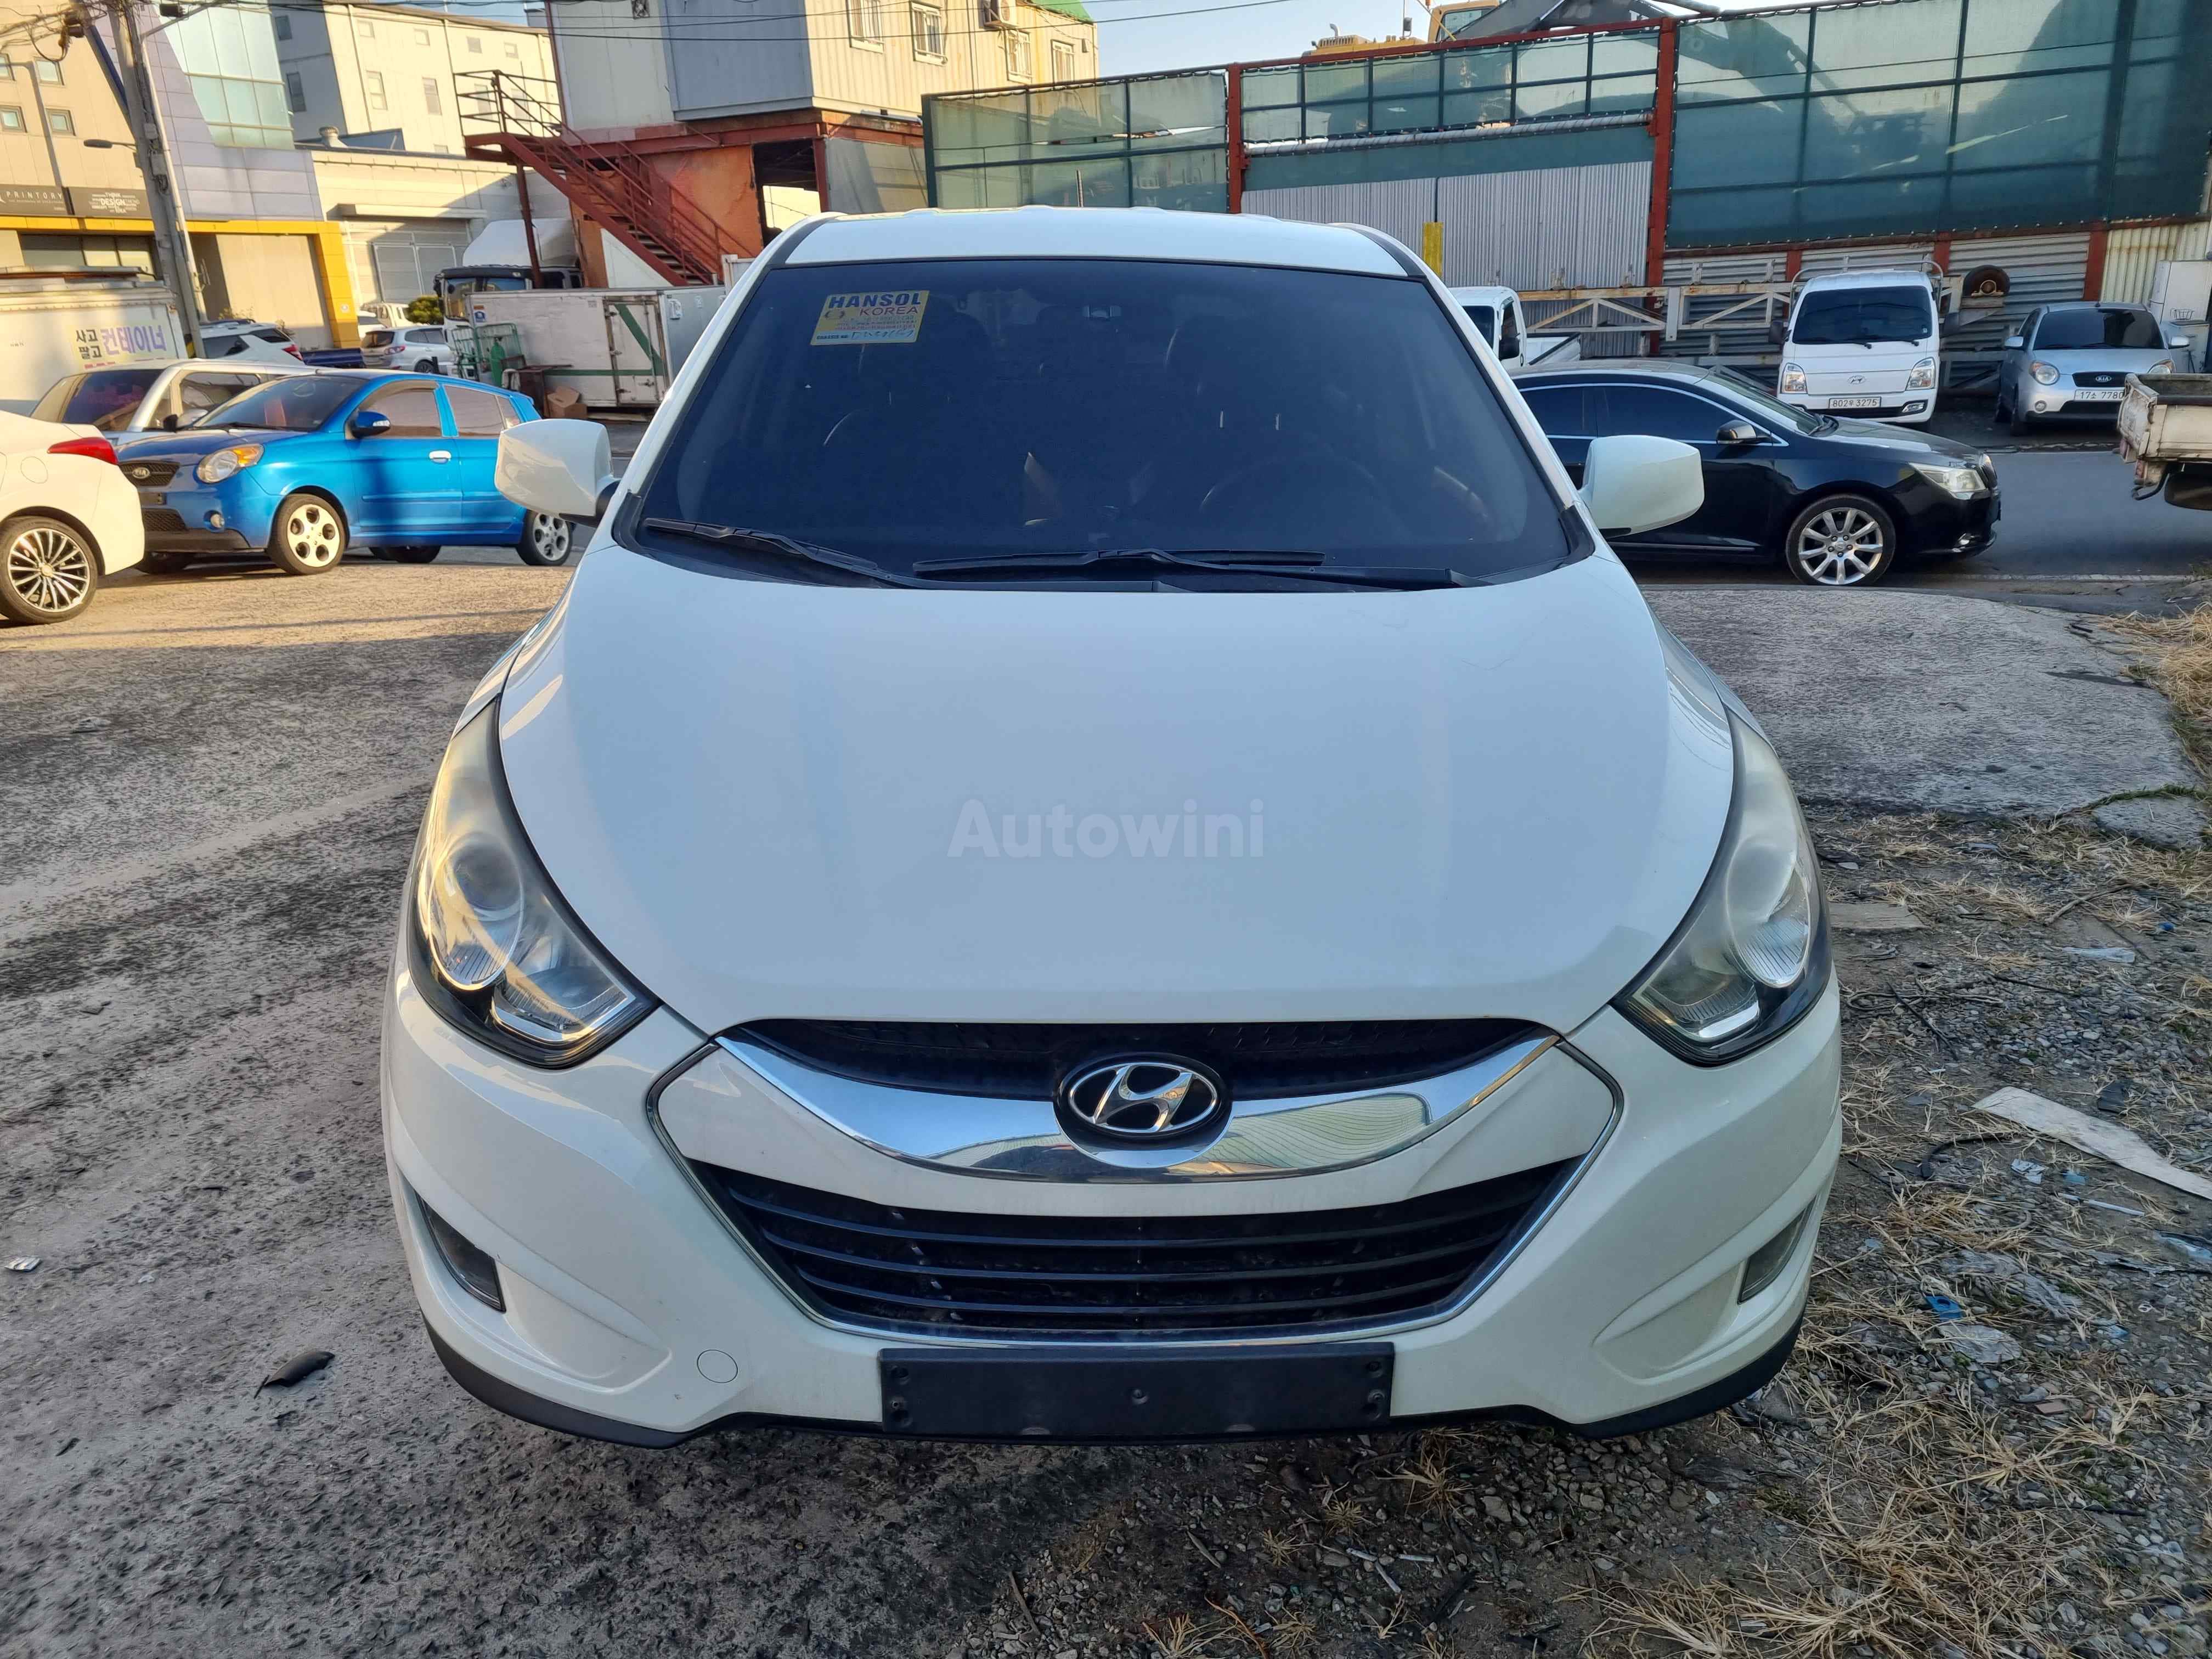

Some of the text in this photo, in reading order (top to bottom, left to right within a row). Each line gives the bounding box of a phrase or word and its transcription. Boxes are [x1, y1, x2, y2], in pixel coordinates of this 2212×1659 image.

[6, 191, 62, 200] PRINTORY
[100, 198, 126, 206] DESIGN
[828, 293, 922, 308] HANSOL
[860, 306, 918, 317] KOREA
[76, 329, 98, 343] 사고
[100, 325, 167, 356] 컨테이너
